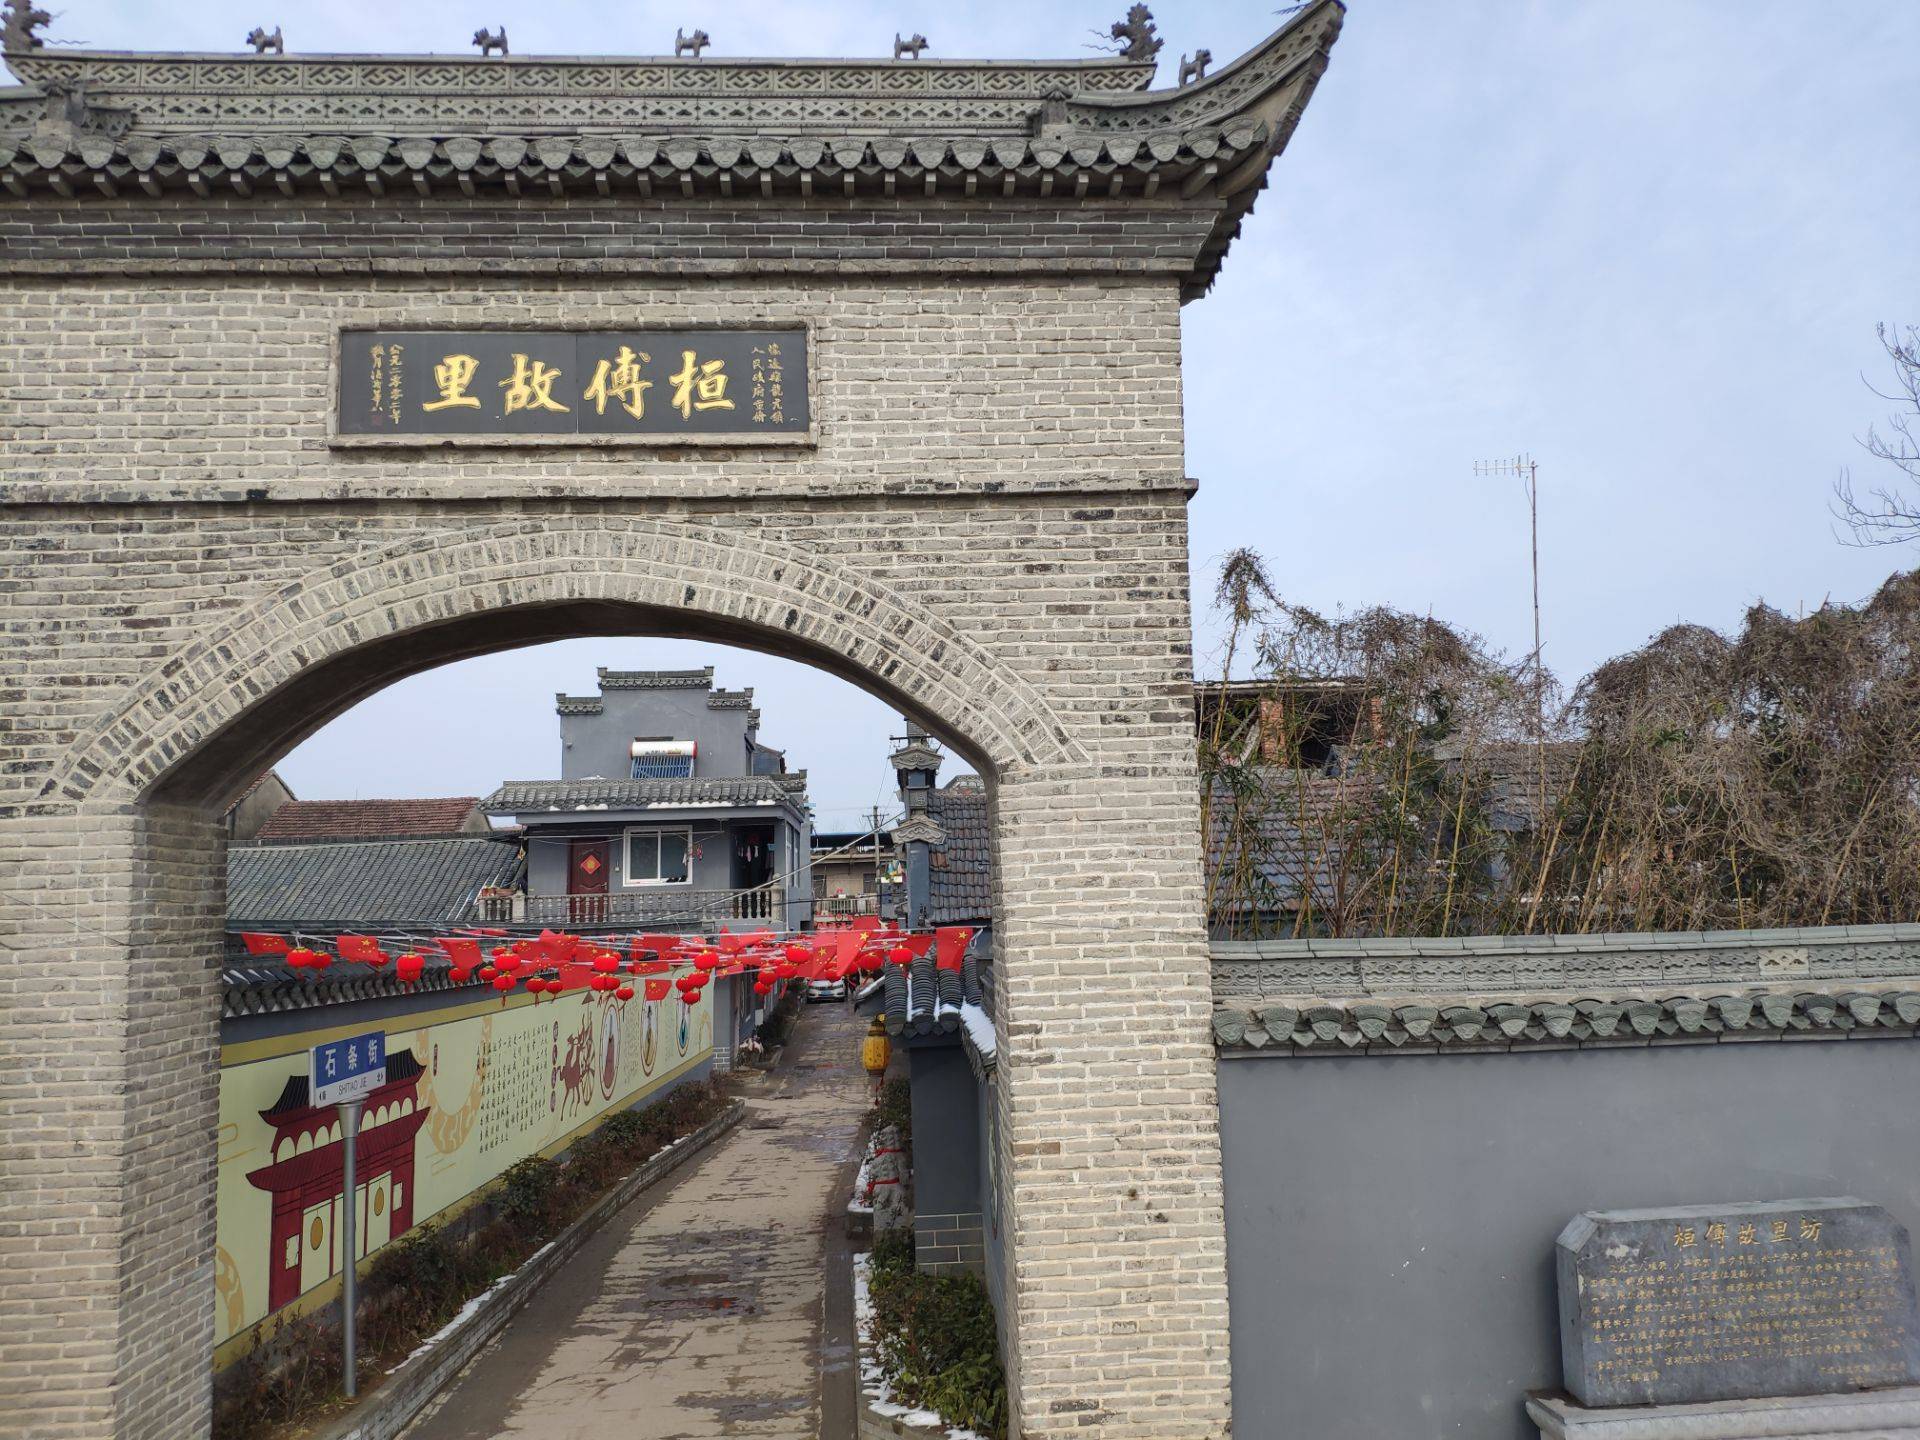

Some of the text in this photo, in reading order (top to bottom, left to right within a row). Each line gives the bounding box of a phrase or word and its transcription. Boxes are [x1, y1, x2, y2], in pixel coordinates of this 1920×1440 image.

[325, 1039, 378, 1078] 石条街
[1674, 1215, 1823, 1251] 桓傅故里坊
